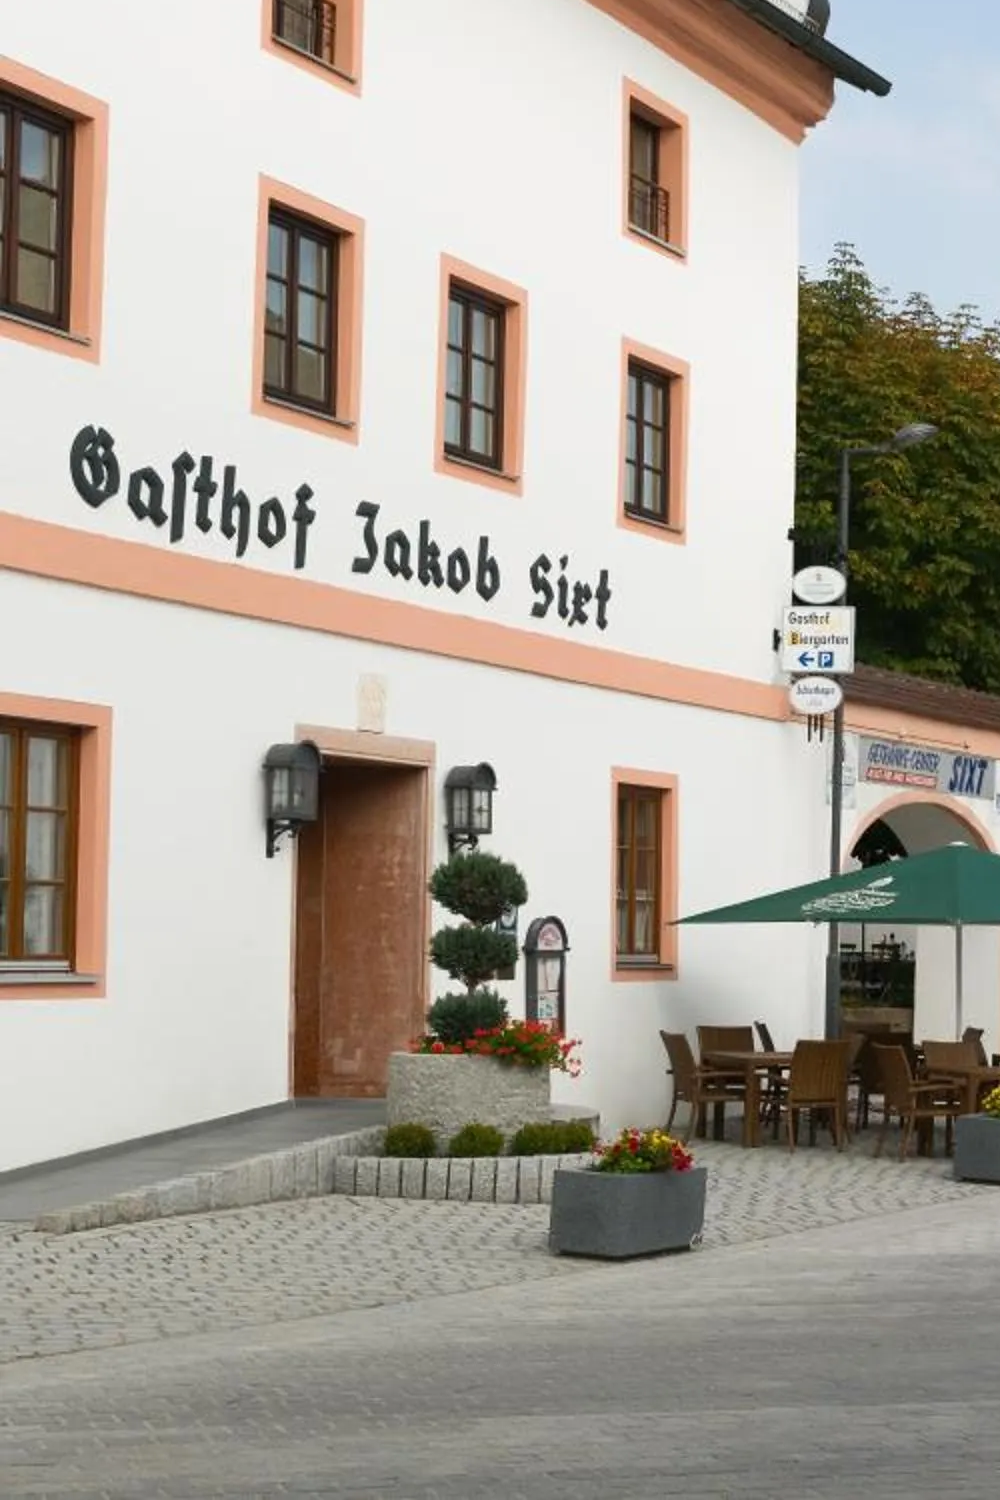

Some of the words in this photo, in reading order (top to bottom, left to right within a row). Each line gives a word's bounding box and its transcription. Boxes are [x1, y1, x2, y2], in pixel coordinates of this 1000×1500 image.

[352, 500, 500, 602] Jakob
[530, 553, 612, 630] Sixt
[788, 611, 830, 626] Gasthof
[791, 631, 849, 648] Biergarten
[949, 755, 988, 795] SIXT
